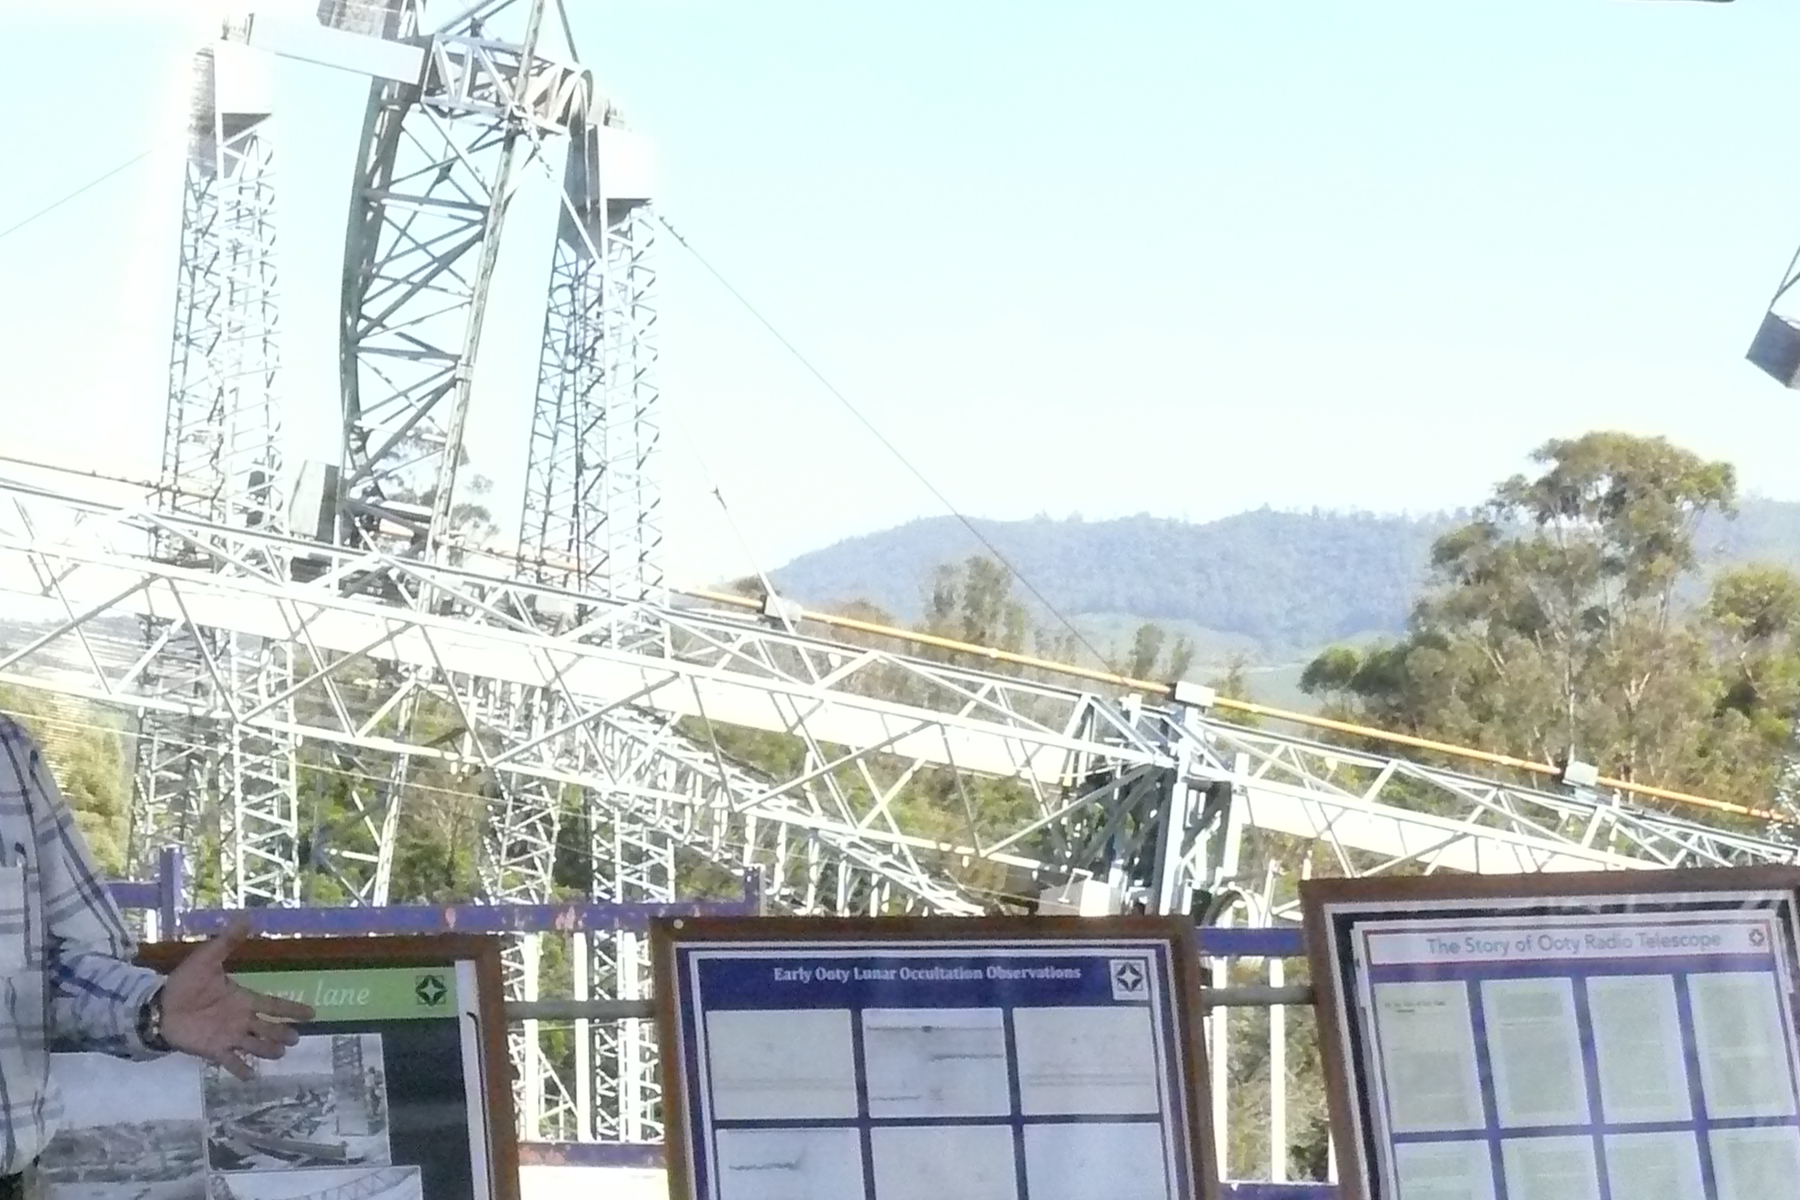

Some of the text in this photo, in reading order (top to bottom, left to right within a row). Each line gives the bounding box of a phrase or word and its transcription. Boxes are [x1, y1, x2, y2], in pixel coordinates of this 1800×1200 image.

[1426, 931, 1722, 957] The Story of Ooty Radio Telescope
[773, 965, 1082, 984] Early Ooty Lunar Occultation Observations
[314, 978, 371, 1007] lane
